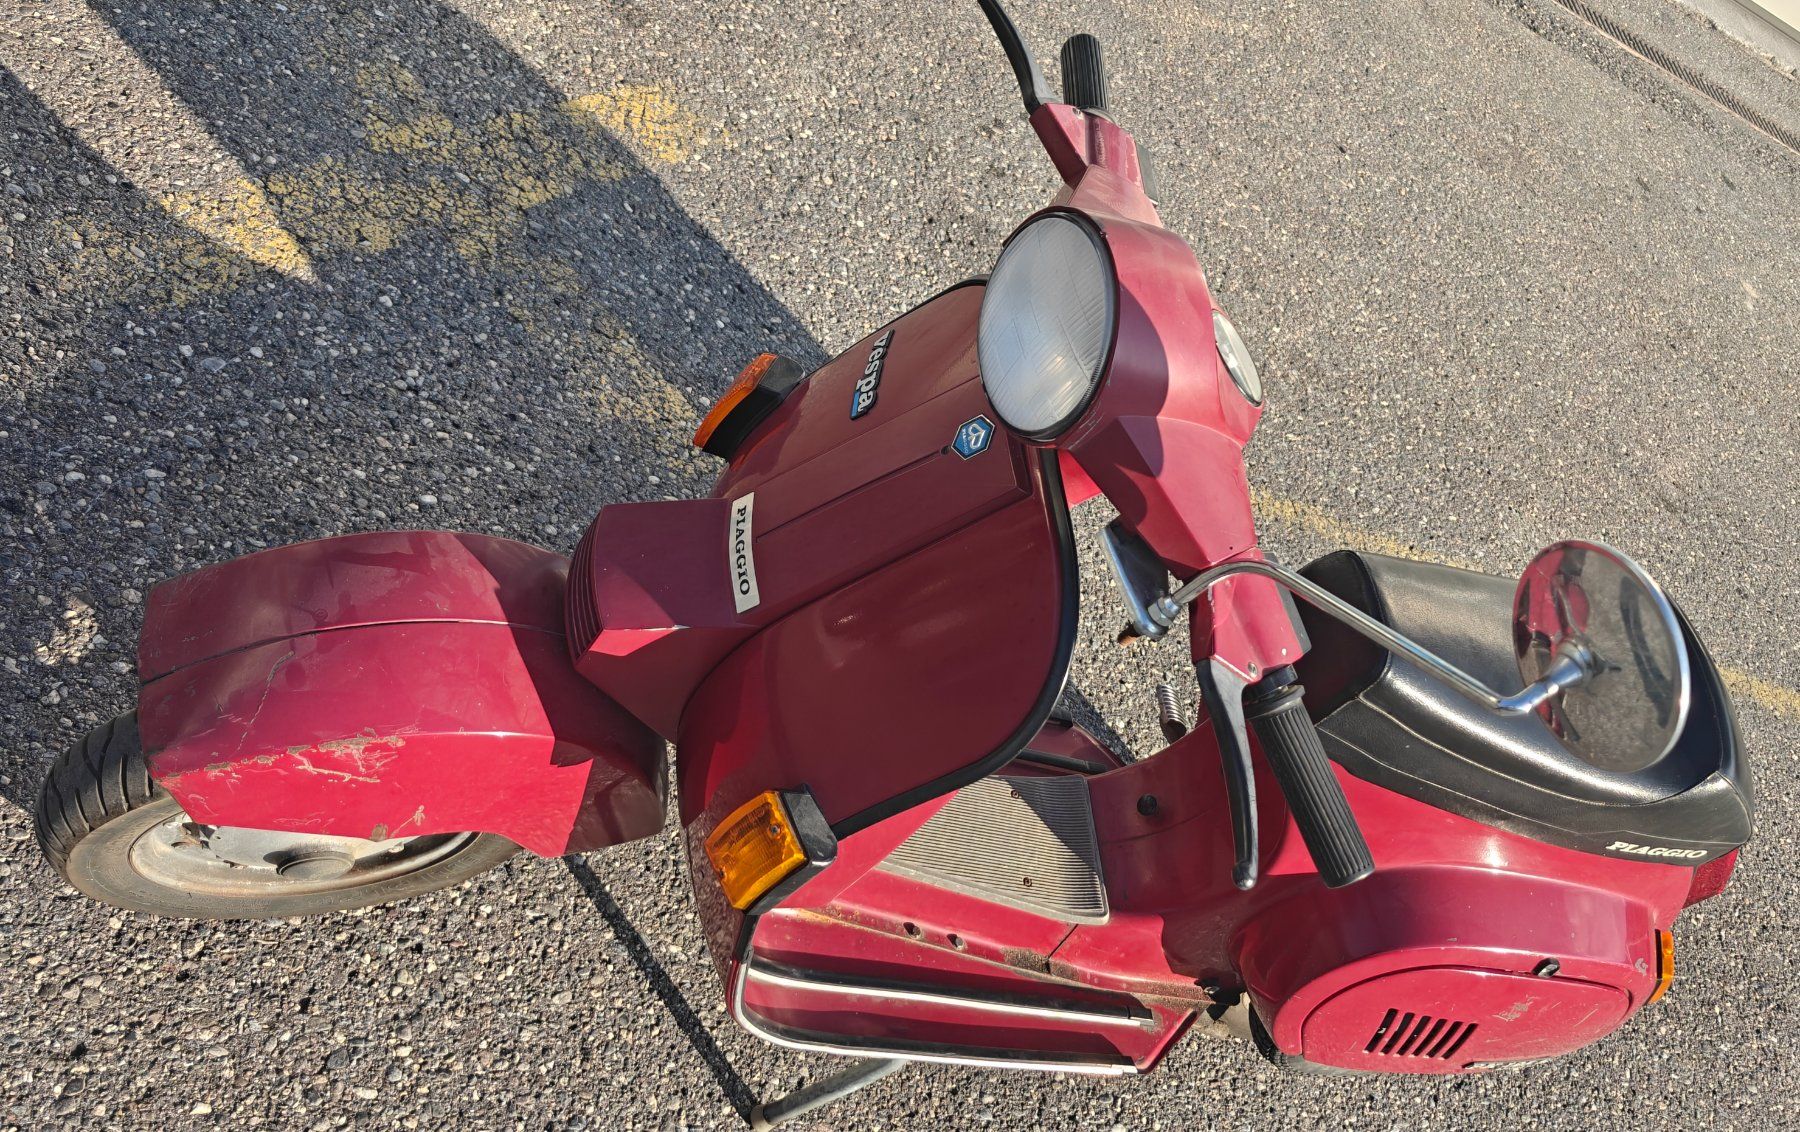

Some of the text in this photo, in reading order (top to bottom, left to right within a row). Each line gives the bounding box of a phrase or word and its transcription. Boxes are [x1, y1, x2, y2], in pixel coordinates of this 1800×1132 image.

[855, 329, 891, 412] vespa
[735, 505, 750, 596] PIAGGIO
[1605, 841, 1708, 859] PIAGGIO
